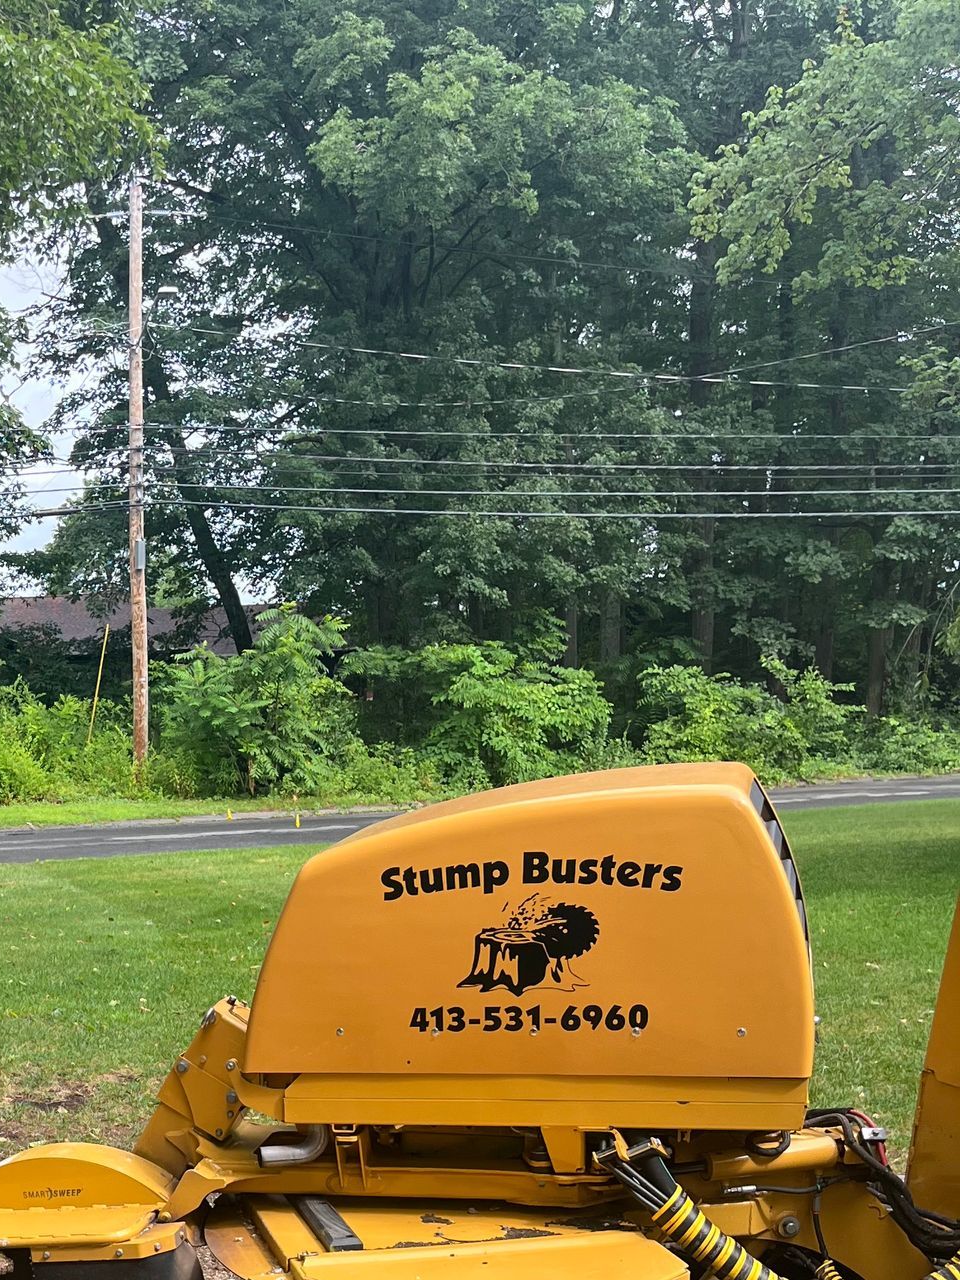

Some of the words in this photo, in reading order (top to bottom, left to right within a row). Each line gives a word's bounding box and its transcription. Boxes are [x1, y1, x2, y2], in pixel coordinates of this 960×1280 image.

[381, 860, 509, 901] Stump
[523, 851, 683, 892] Busters
[410, 1004, 648, 1032] 413-531-6960
